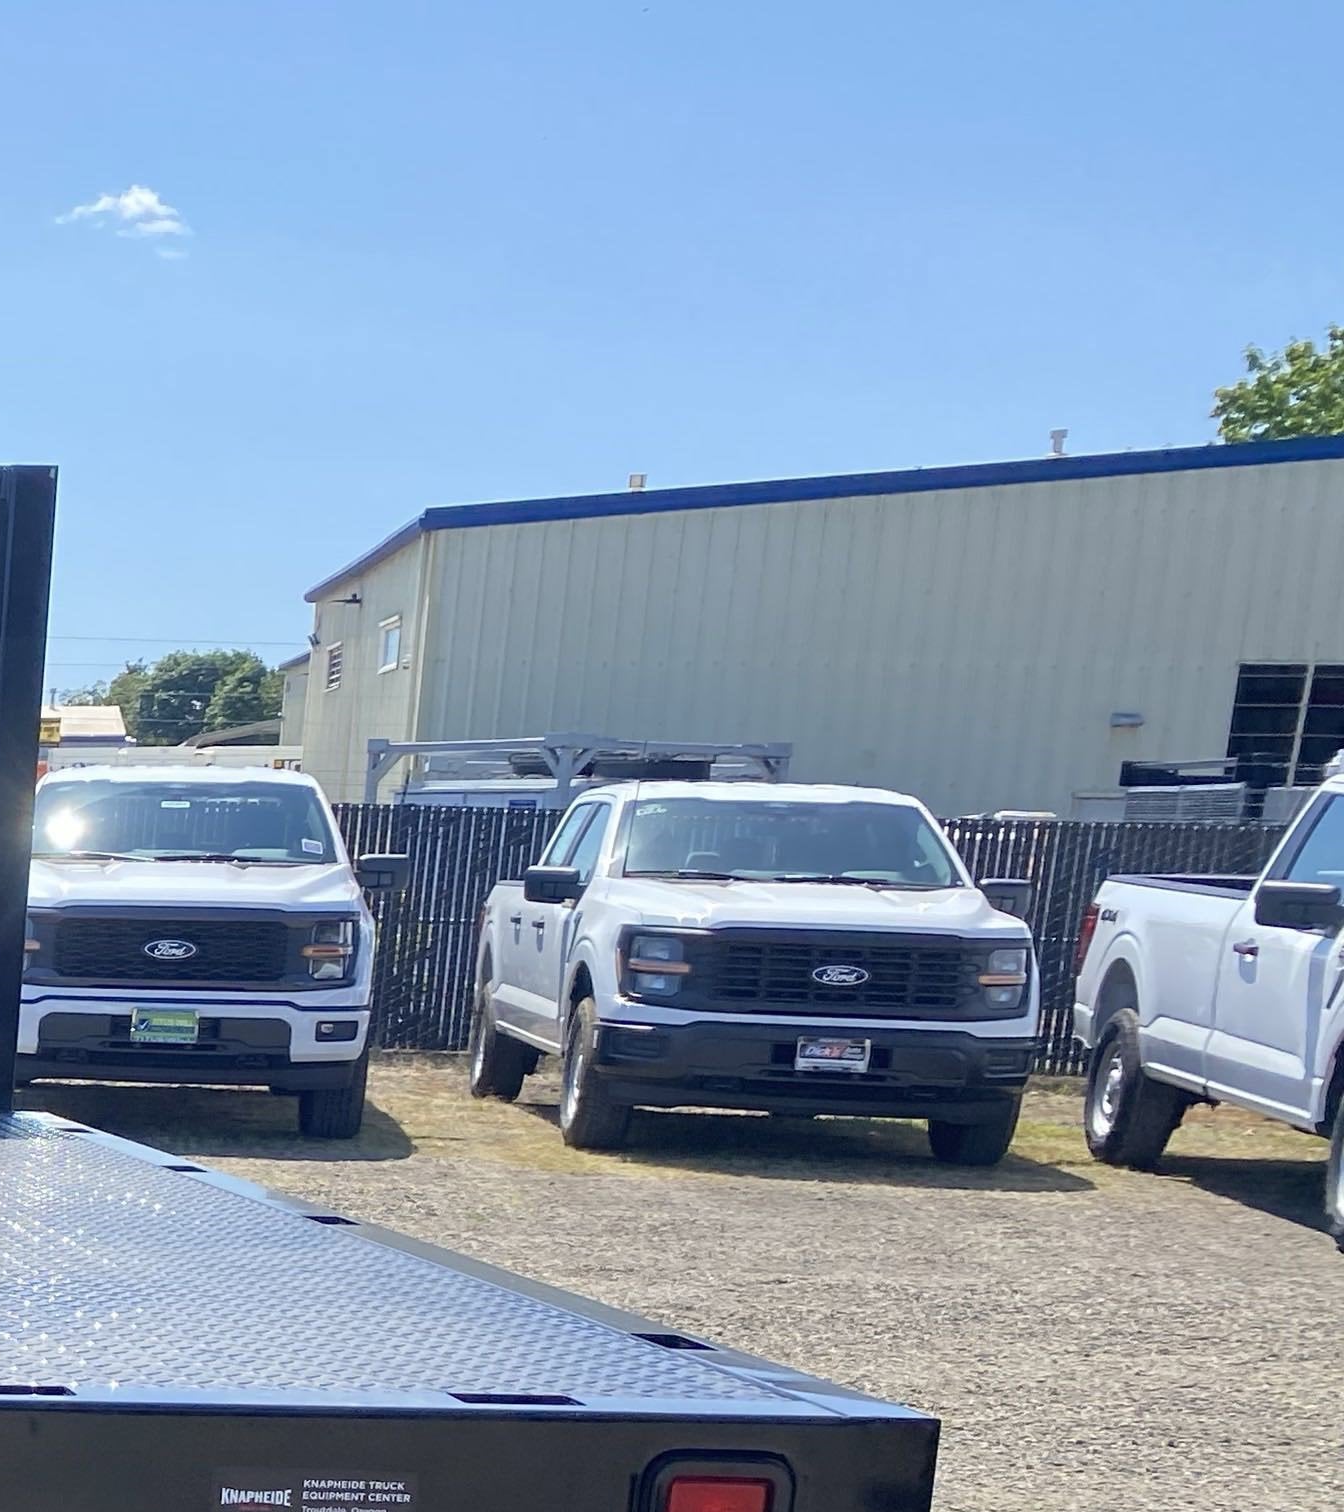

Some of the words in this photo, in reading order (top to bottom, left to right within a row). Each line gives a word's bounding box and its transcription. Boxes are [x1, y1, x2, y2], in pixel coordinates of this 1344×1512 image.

[303, 1479, 366, 1490] KNAPHEIDE
[368, 1481, 406, 1491] TRUCK
[220, 1487, 293, 1507] KNAPHEIDE
[301, 1490, 366, 1502] EQUIPMENT
[368, 1493, 411, 1503] CENTER
